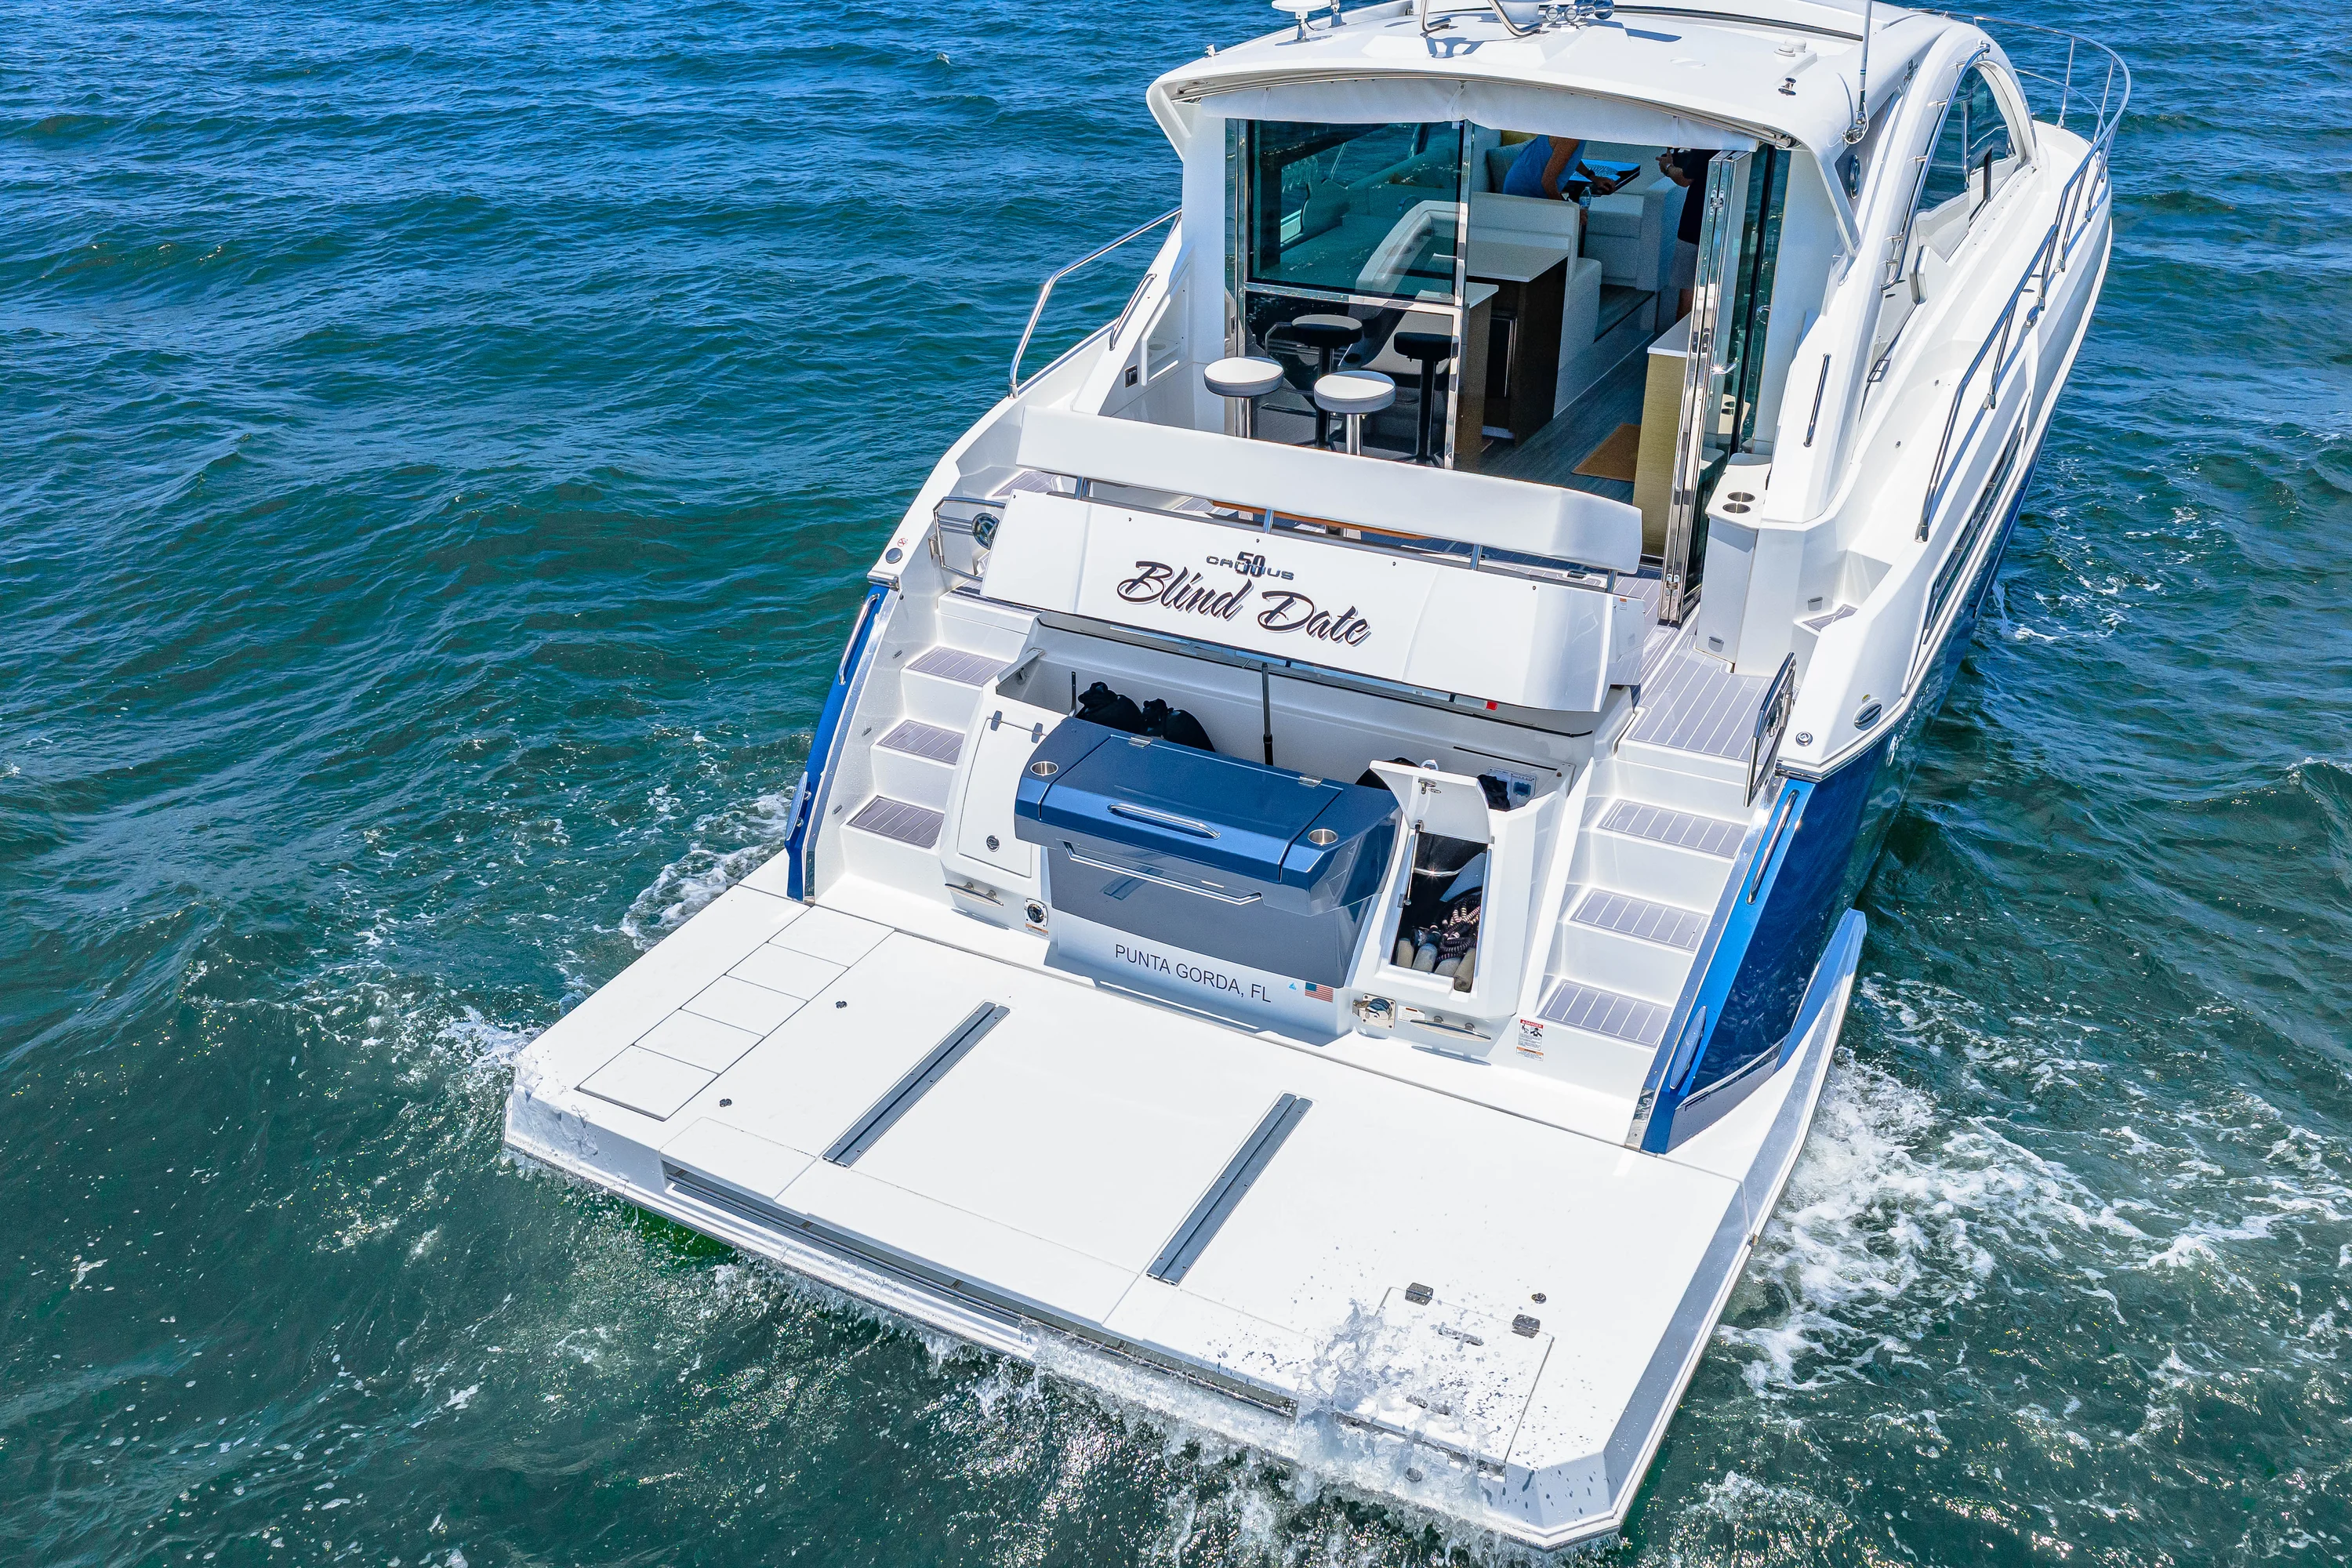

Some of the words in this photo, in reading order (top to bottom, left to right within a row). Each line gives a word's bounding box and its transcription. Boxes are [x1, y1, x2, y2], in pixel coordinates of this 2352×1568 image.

[1235, 551, 1266, 578] 50
[1116, 560, 1254, 621] Blind
[1257, 590, 1372, 646] Date
[1115, 943, 1171, 975] PUNTA
[1175, 963, 1245, 998] GORDA,
[1250, 983, 1272, 1003] FL
